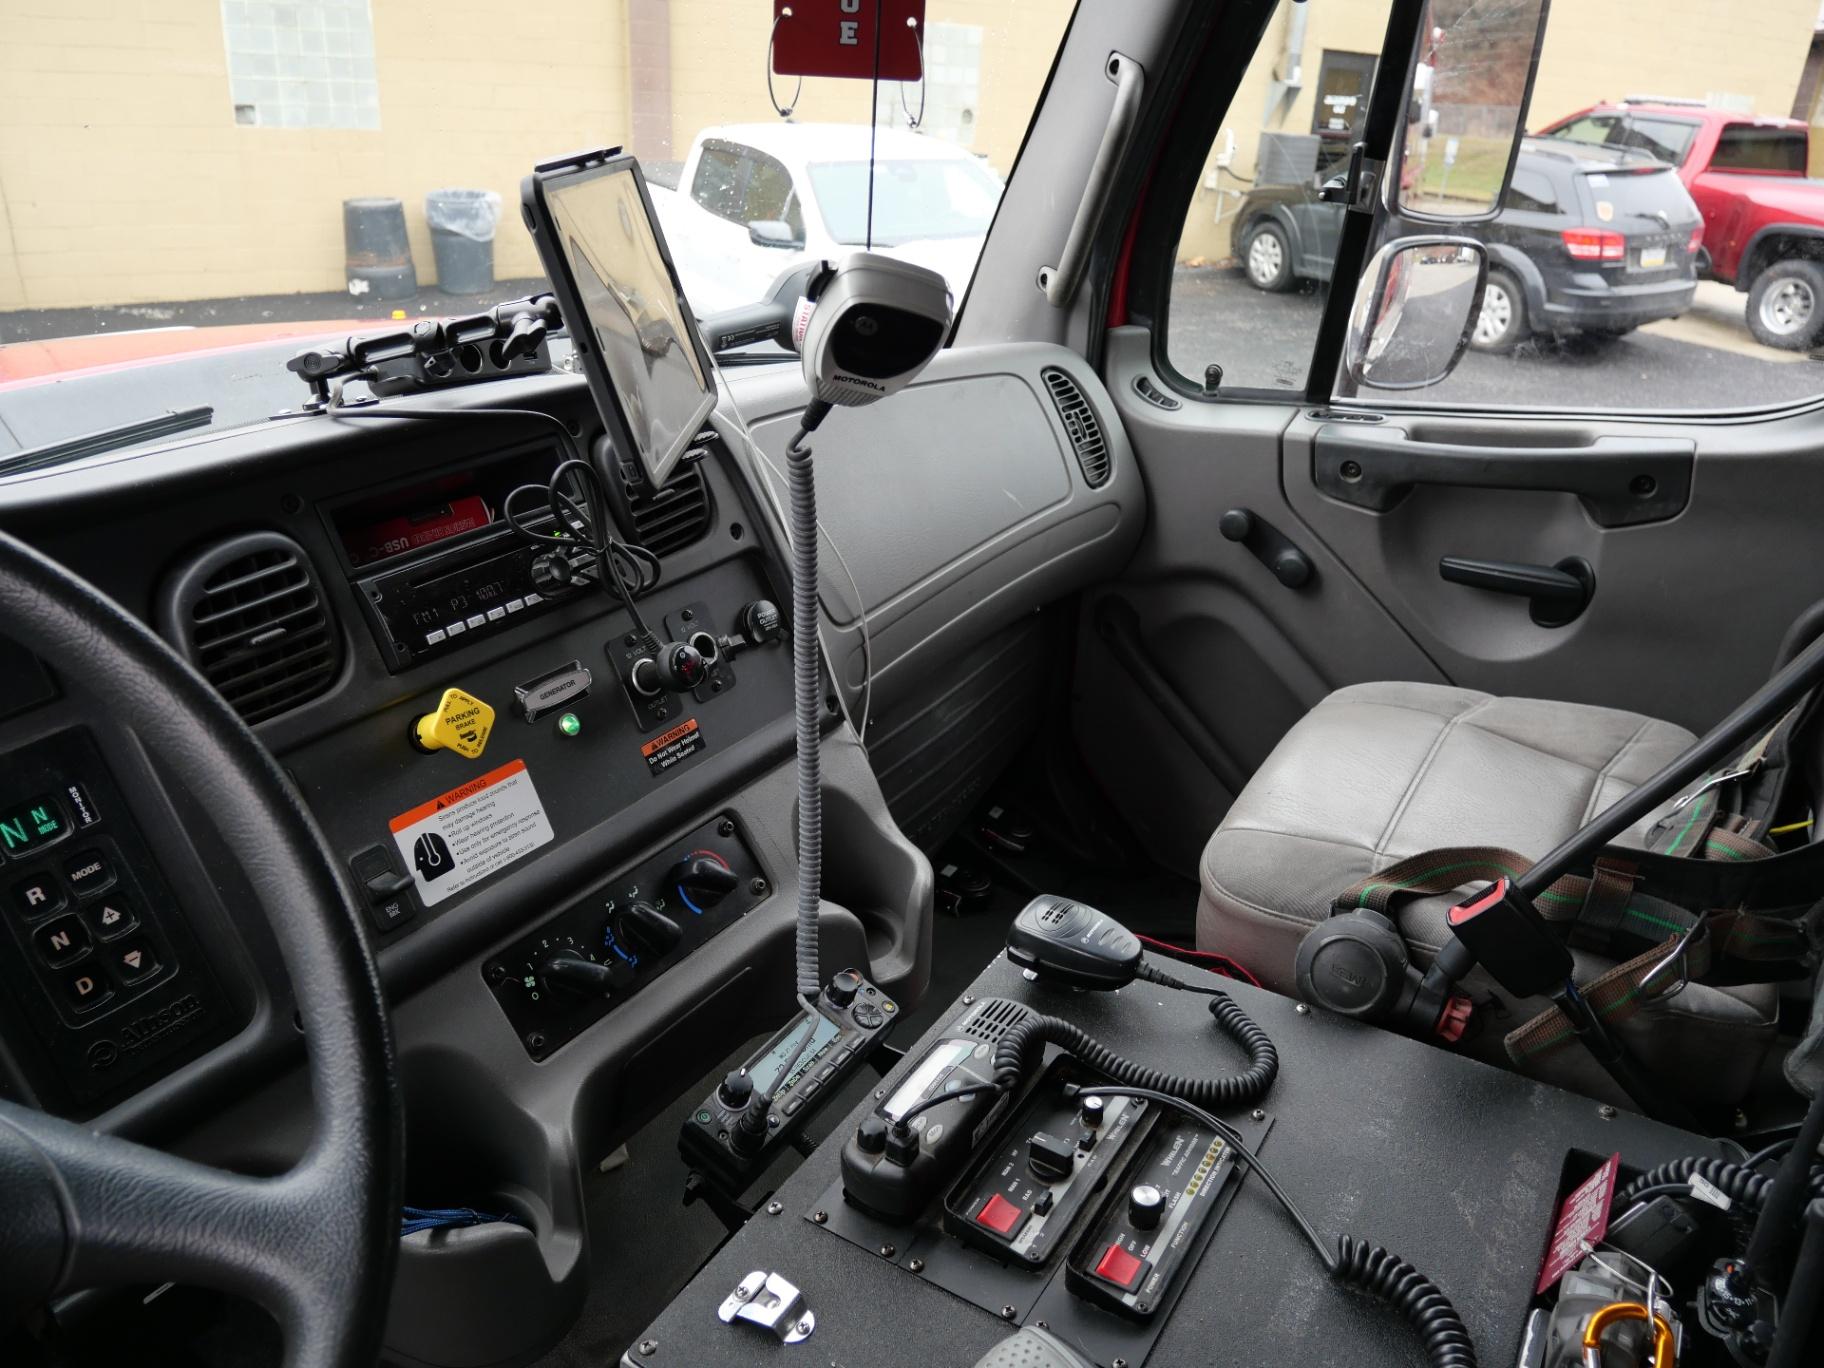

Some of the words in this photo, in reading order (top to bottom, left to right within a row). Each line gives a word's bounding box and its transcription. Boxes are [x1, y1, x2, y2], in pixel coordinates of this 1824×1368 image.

[832, 374, 886, 393] MOTOROLA
[368, 536, 410, 559] USB-C
[539, 679, 576, 701] GENERATOR
[445, 707, 480, 726] PARKING
[455, 718, 476, 732] BRAKE
[656, 724, 690, 744] WARNING
[648, 755, 657, 764] Do
[657, 749, 667, 759] Not
[667, 742, 681, 752] Wear
[681, 732, 699, 744] Helmet
[661, 756, 676, 767] While
[676, 745, 695, 758] Seated
[438, 810, 454, 820] Sirens
[456, 799, 476, 812] produce
[507, 778, 517, 787] that
[446, 779, 486, 803] WARNING
[68, 785, 93, 824] MONITOR
[0, 817, 29, 849] N
[30, 805, 49, 823] N
[37, 819, 59, 835] MODE
[442, 821, 453, 831] may
[454, 811, 475, 824] damage
[476, 801, 495, 813] hearing
[470, 813, 491, 826] windows
[470, 825, 488, 837] hearing
[489, 812, 514, 828] protection
[470, 839, 481, 848] only
[481, 834, 490, 842] for
[490, 821, 518, 839] emergency
[518, 809, 540, 824] response
[478, 840, 501, 854] exposure
[521, 822, 536, 832] sound
[466, 859, 485, 871] outside
[491, 846, 509, 858] vehicle
[70, 861, 103, 882] MODE
[447, 883, 458, 891] Refer
[464, 866, 489, 882] instructions
[25, 885, 47, 906] R
[49, 930, 71, 952] N
[541, 939, 549, 949] 2
[566, 936, 575, 946] 3
[525, 962, 534, 971] 1
[74, 975, 94, 996] D
[1161, 1137, 1183, 1167] WHELEN
[1172, 1157, 1186, 1175] TRAFFIC
[1198, 1171, 1217, 1196] DIRECTION
[1168, 1191, 1181, 1208] FLASH
[1127, 1240, 1136, 1250] OFF
[1170, 1221, 1189, 1248] FUNCTION
[1140, 1244, 1150, 1257] LOW
[1145, 1273, 1160, 1292] POWER
